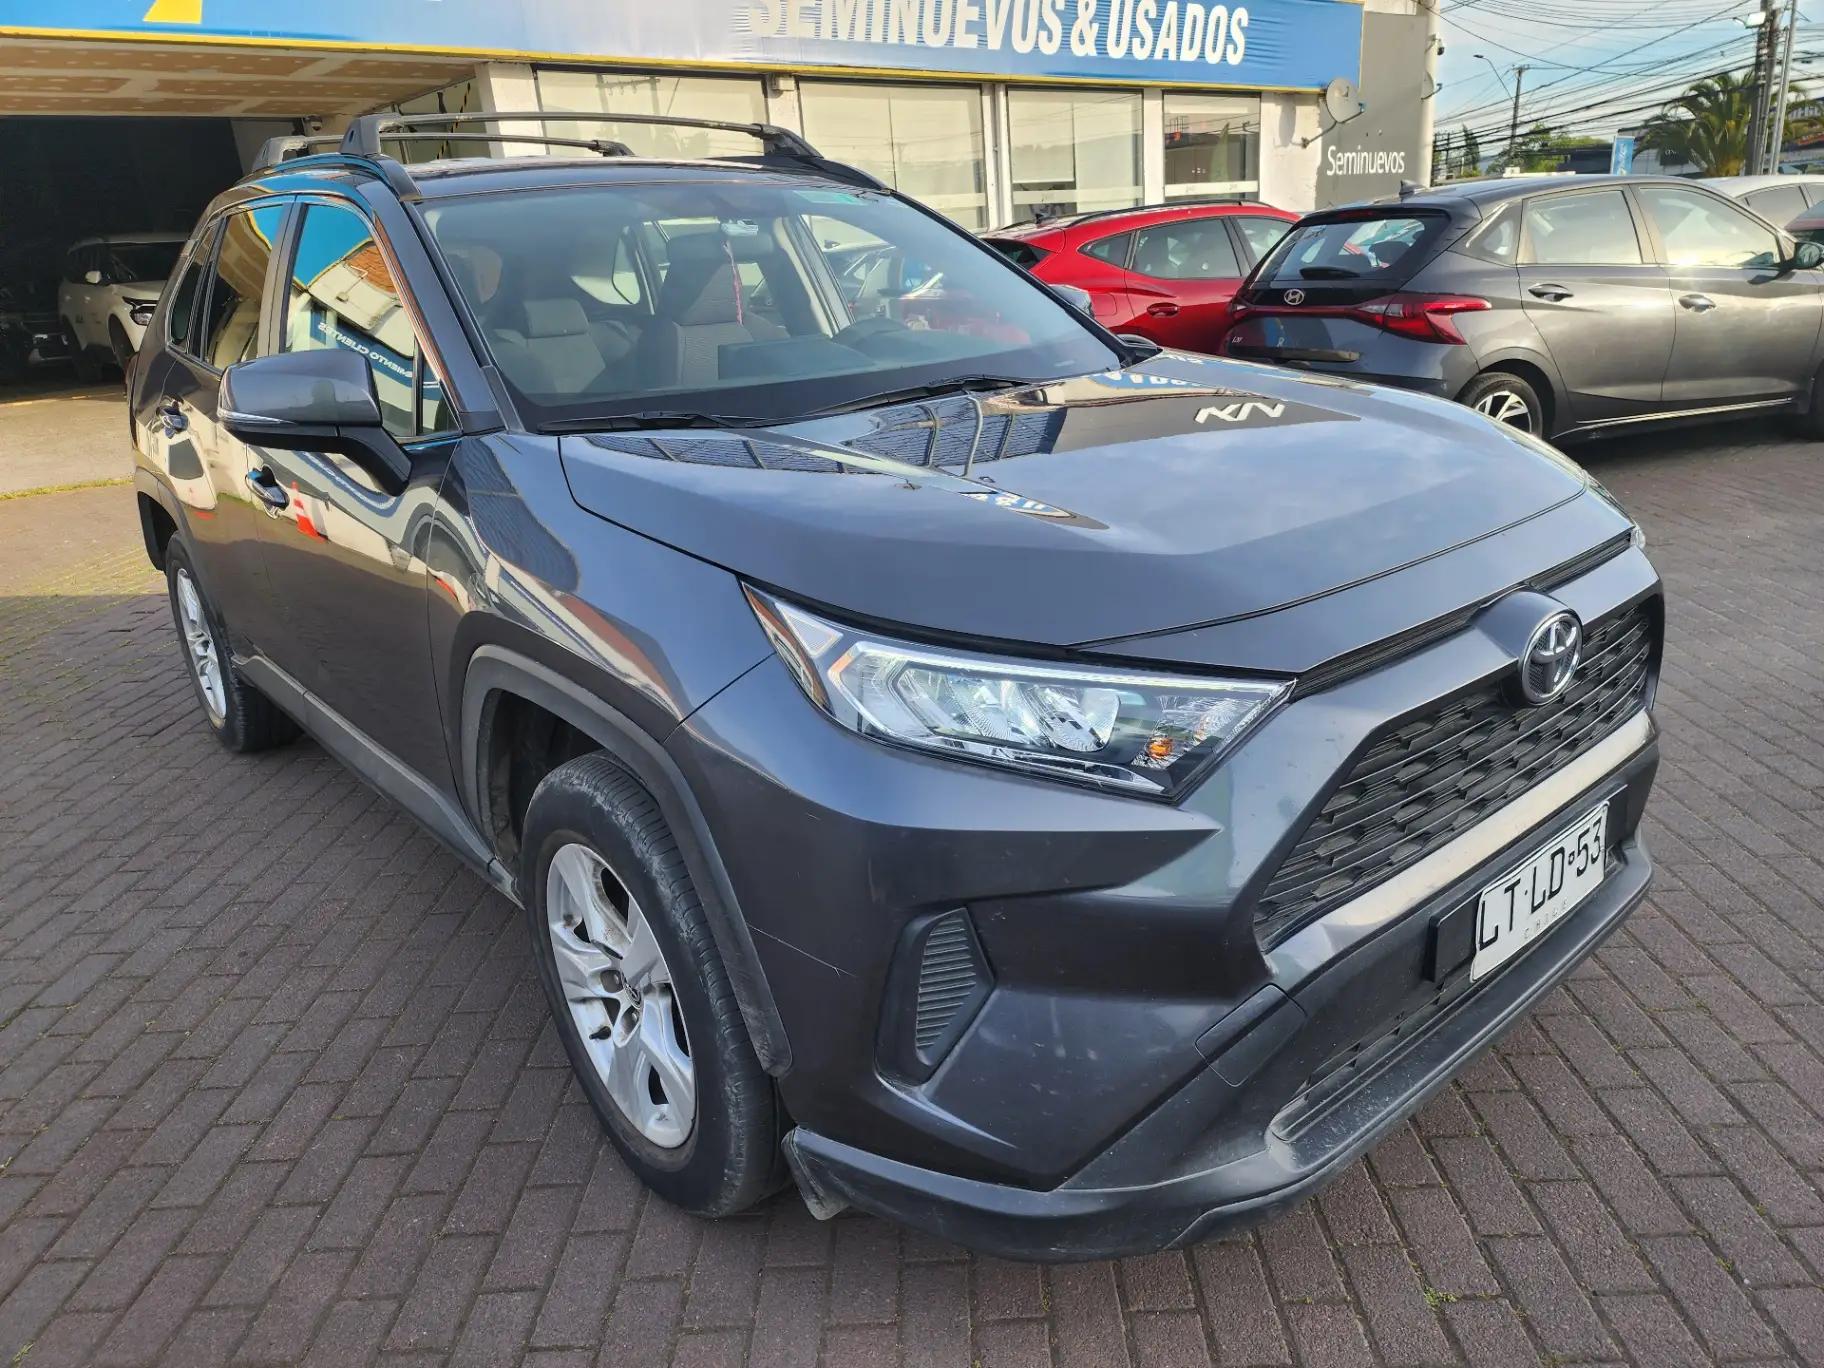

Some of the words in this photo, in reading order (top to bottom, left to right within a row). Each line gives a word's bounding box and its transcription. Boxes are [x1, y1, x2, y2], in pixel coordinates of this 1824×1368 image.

[748, 0, 1065, 55] SEMINUEVOS
[1071, 0, 1099, 57] &
[1107, 0, 1249, 65] USADOS
[1326, 144, 1405, 176] Seminuevos
